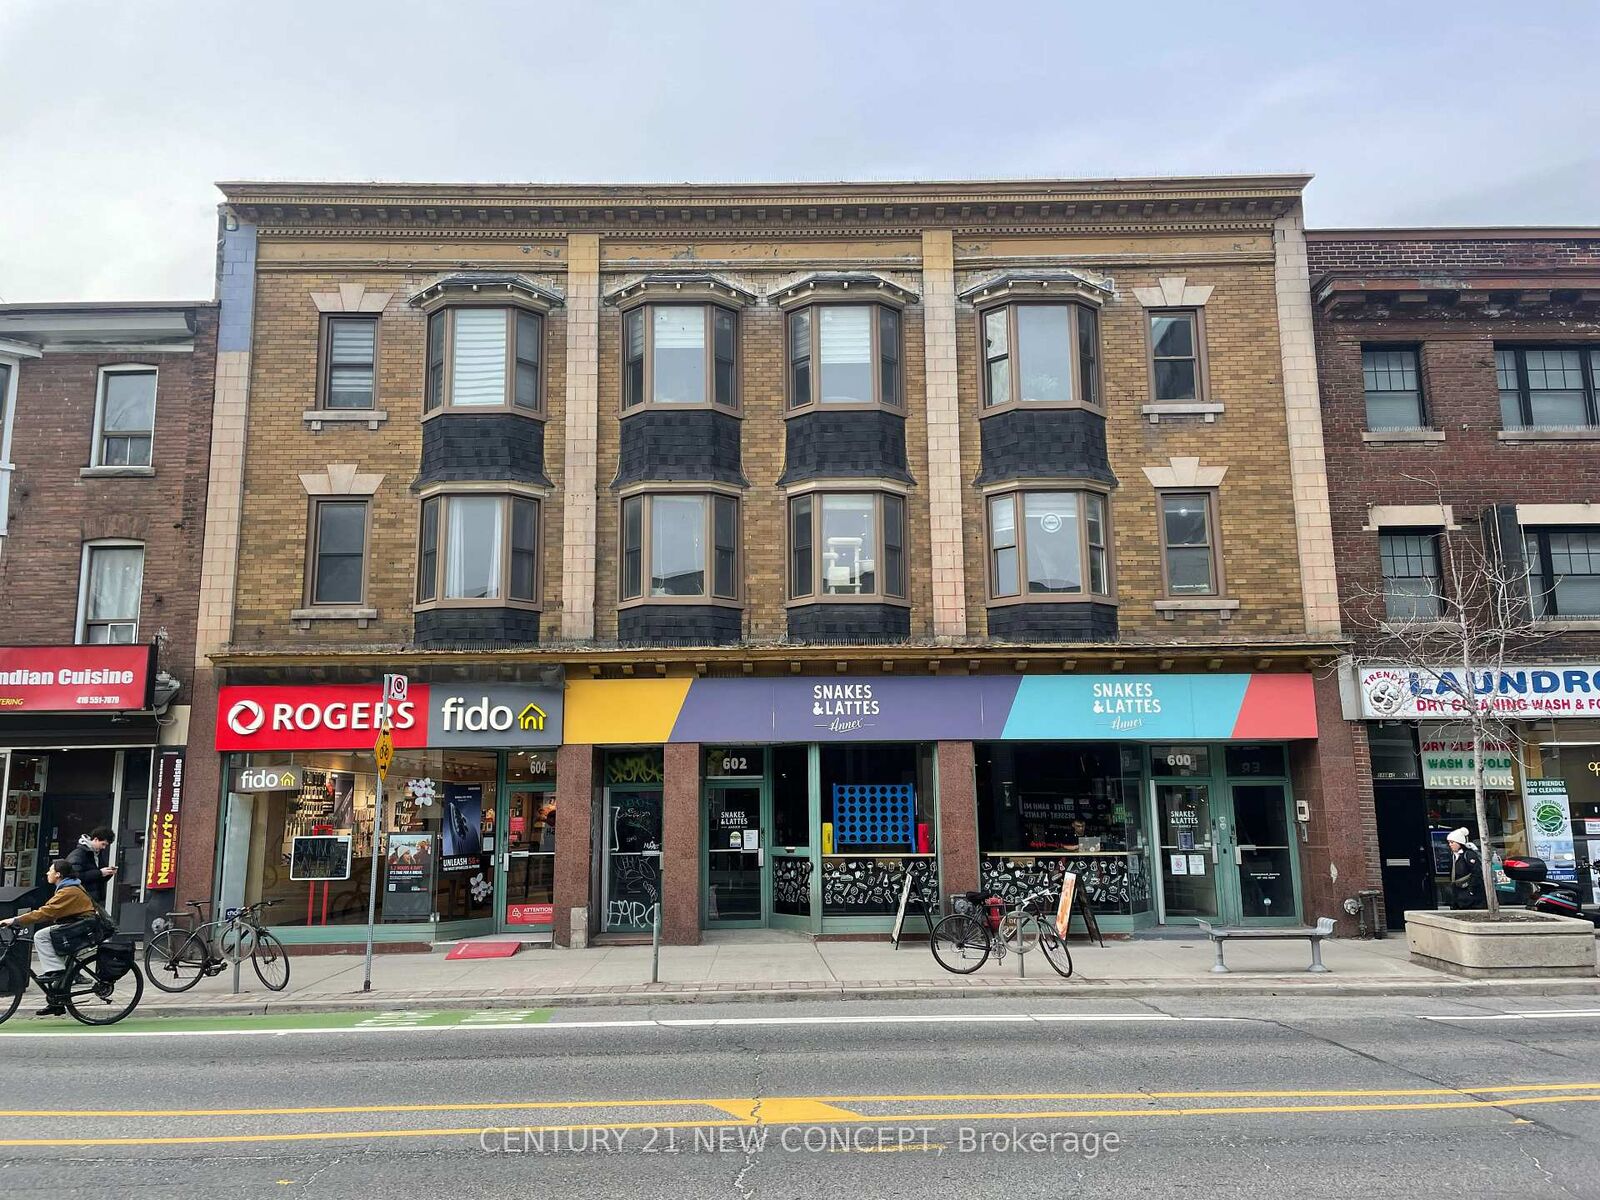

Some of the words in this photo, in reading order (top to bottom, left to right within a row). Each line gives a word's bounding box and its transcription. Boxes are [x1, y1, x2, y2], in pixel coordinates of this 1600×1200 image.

[58, 669, 134, 684] Cuisine
[1363, 671, 1405, 687] TRENDY
[1409, 671, 1600, 696] LAUNDR
[814, 684, 872, 700] SNAKES
[1093, 682, 1153, 698] SNAKES
[812, 700, 880, 716] &LATTES
[1093, 699, 1162, 714] &LATTES
[1416, 700, 1446, 712] DRY
[1532, 699, 1570, 710] WASH
[1576, 698, 1584, 710] &
[272, 702, 416, 730] ROGERS
[442, 696, 514, 731] fido
[828, 718, 864, 733] Annex
[1422, 741, 1446, 752] DRY
[530, 761, 546, 774] 604
[722, 758, 748, 770] 602
[1167, 754, 1191, 766] 600
[1428, 758, 1463, 768] WASH
[172, 758, 182, 788] Cuisine
[240, 770, 278, 788] fido
[1430, 776, 1514, 786] ALTERAIONS
[170, 788, 180, 812] Indian
[157, 813, 174, 885] Namaste
[443, 857, 468, 867] UNLEASH
